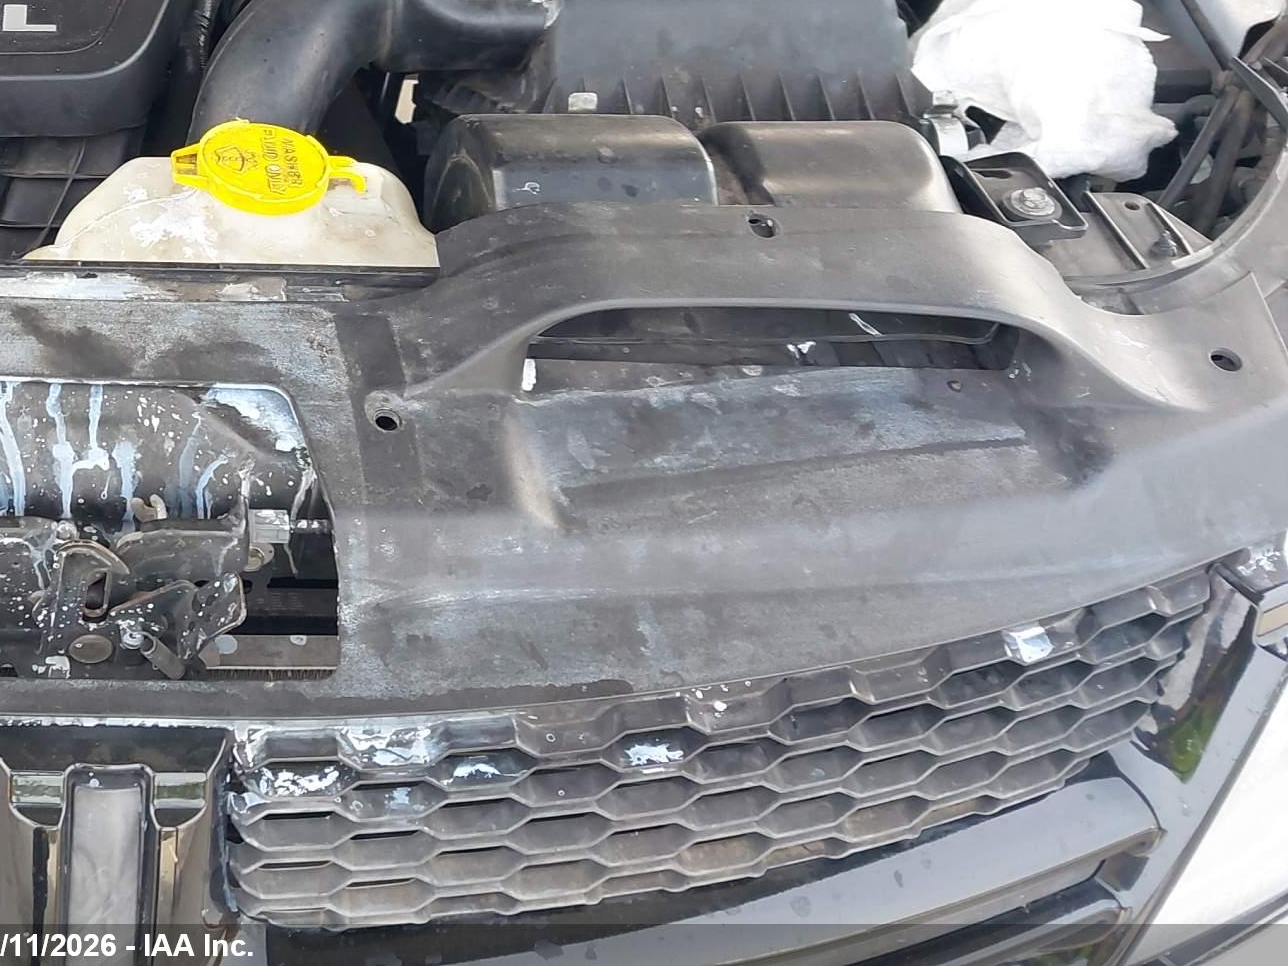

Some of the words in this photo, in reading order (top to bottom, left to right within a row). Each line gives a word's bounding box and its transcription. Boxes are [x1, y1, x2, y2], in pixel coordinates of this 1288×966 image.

[262, 129, 278, 163] FLUID
[280, 137, 303, 188] WASHER
[265, 164, 287, 195] ONLY
